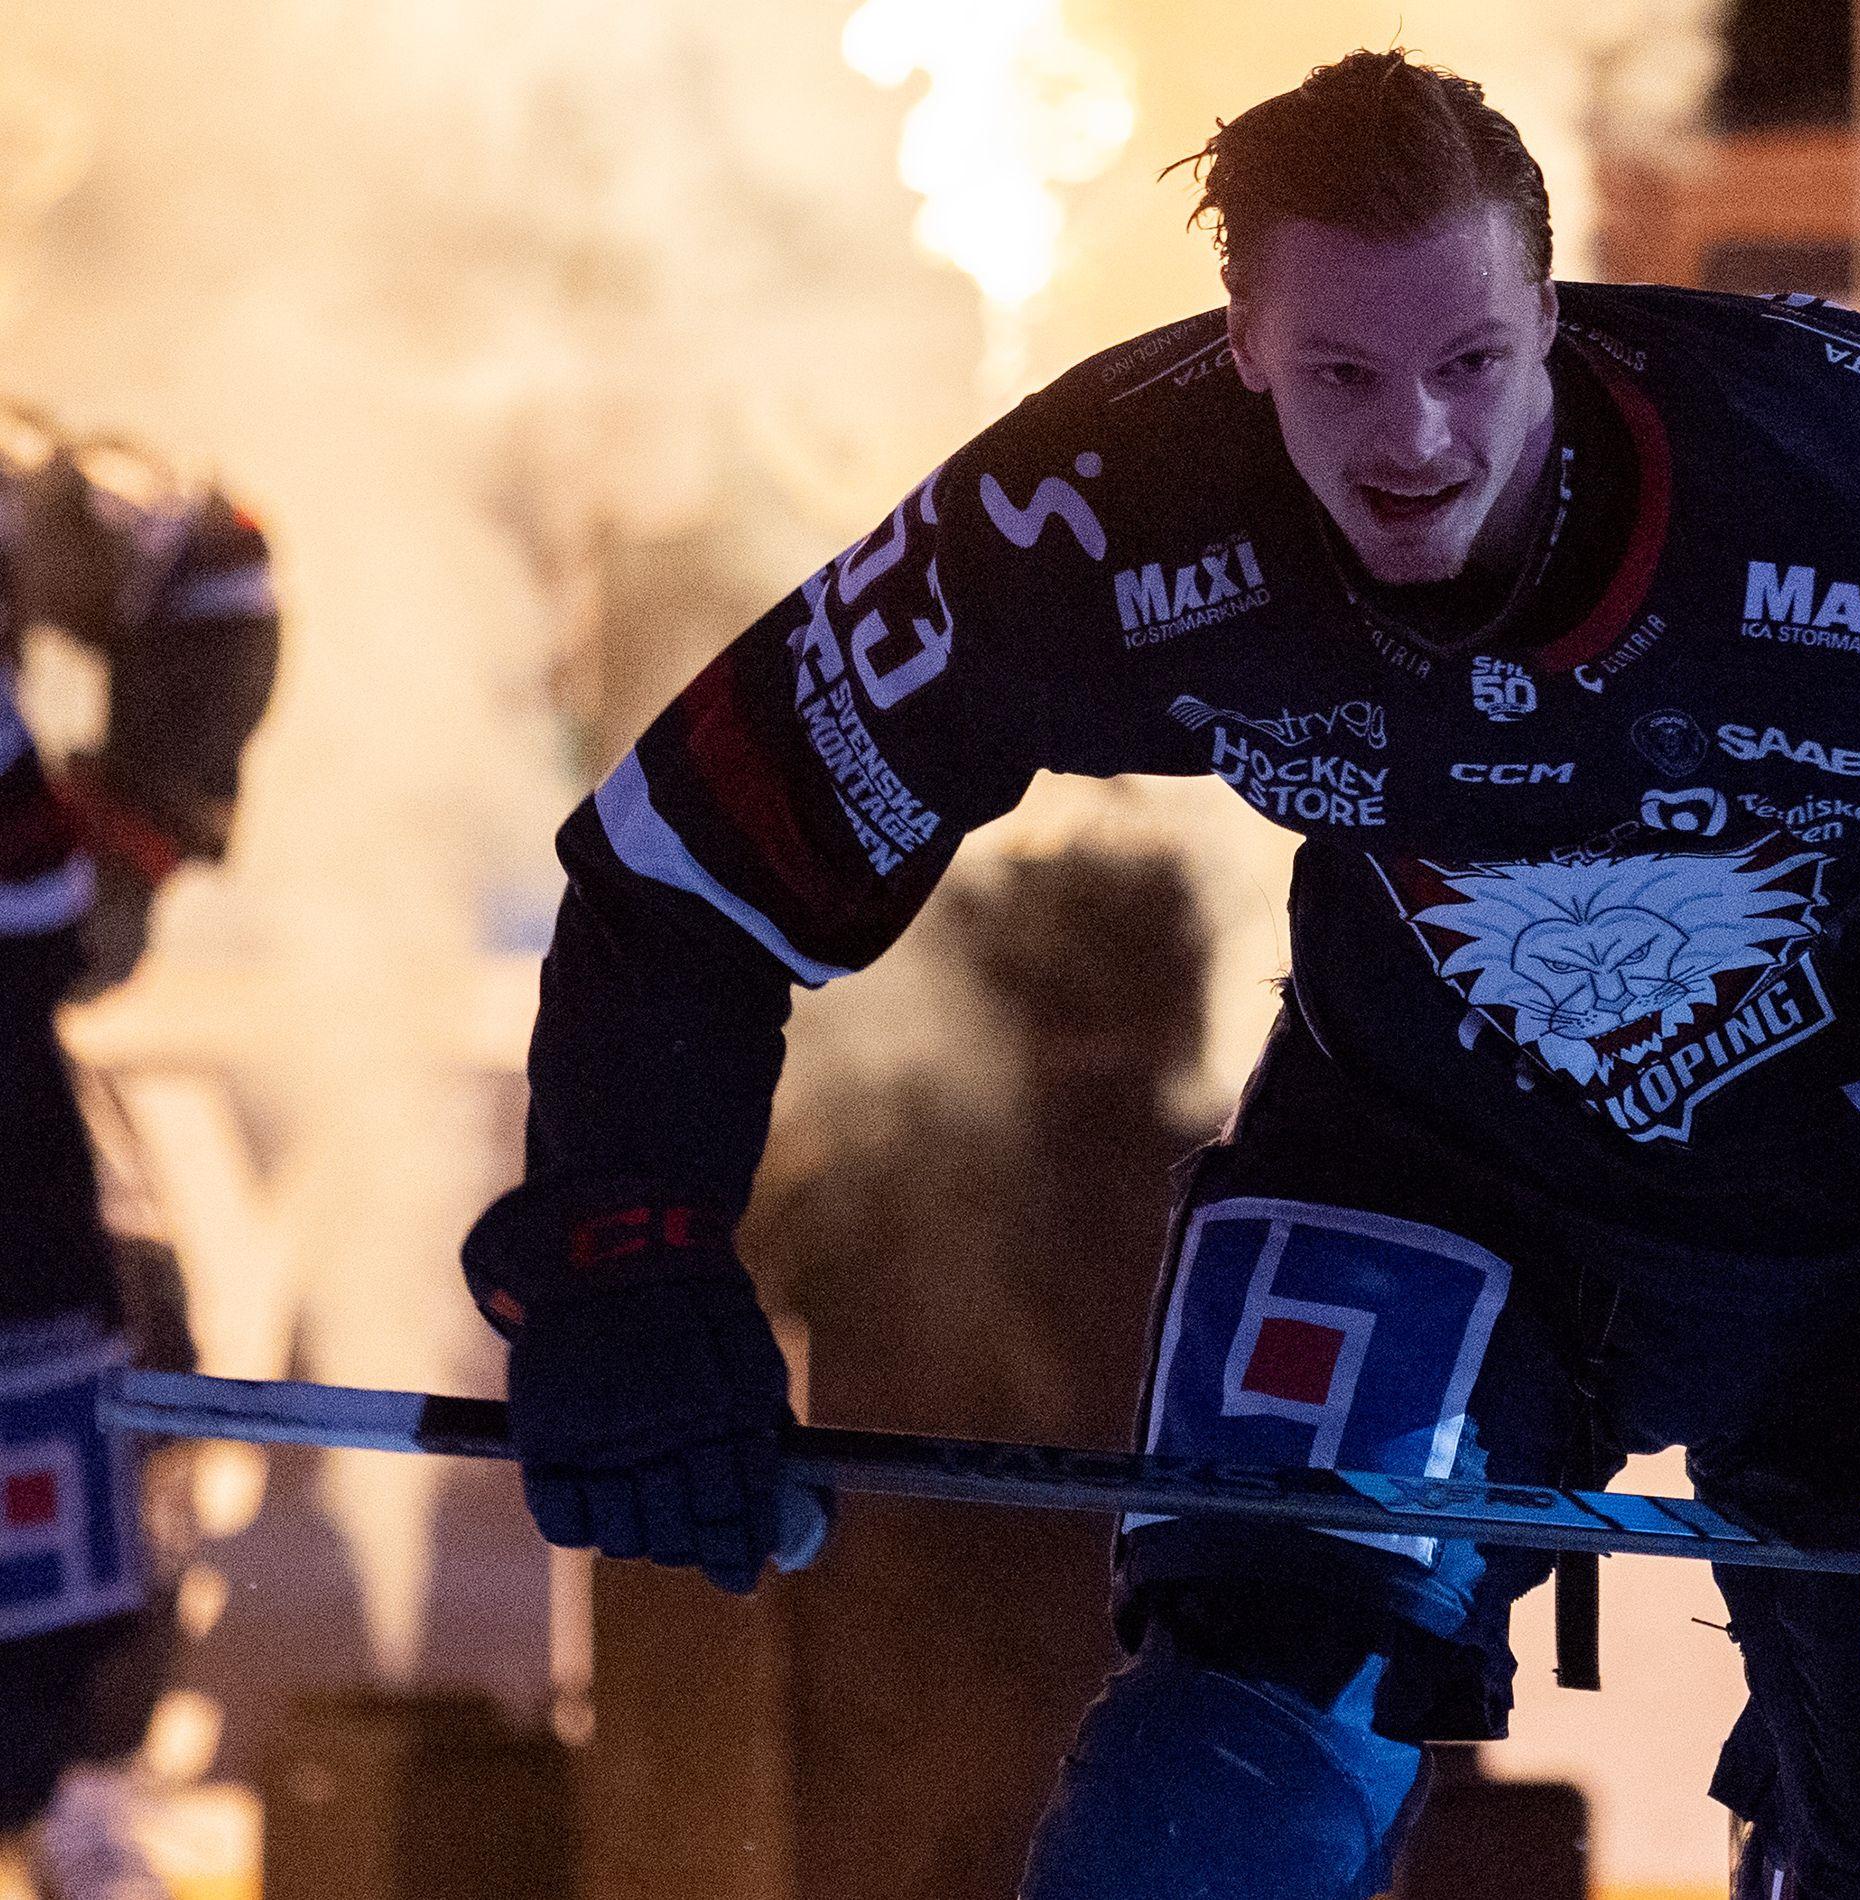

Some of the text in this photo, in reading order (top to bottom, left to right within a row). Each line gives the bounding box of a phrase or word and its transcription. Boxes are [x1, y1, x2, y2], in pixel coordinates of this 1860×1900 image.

[1113, 540, 1266, 631] MAXI
[1471, 674, 1539, 714] 50
[801, 696, 927, 854] MONTAGE
[826, 678, 943, 842] SVENSKA
[1247, 775, 1388, 828] STORE
[1449, 761, 1577, 785] CCM
[1604, 978, 1806, 1132] KÖPING
